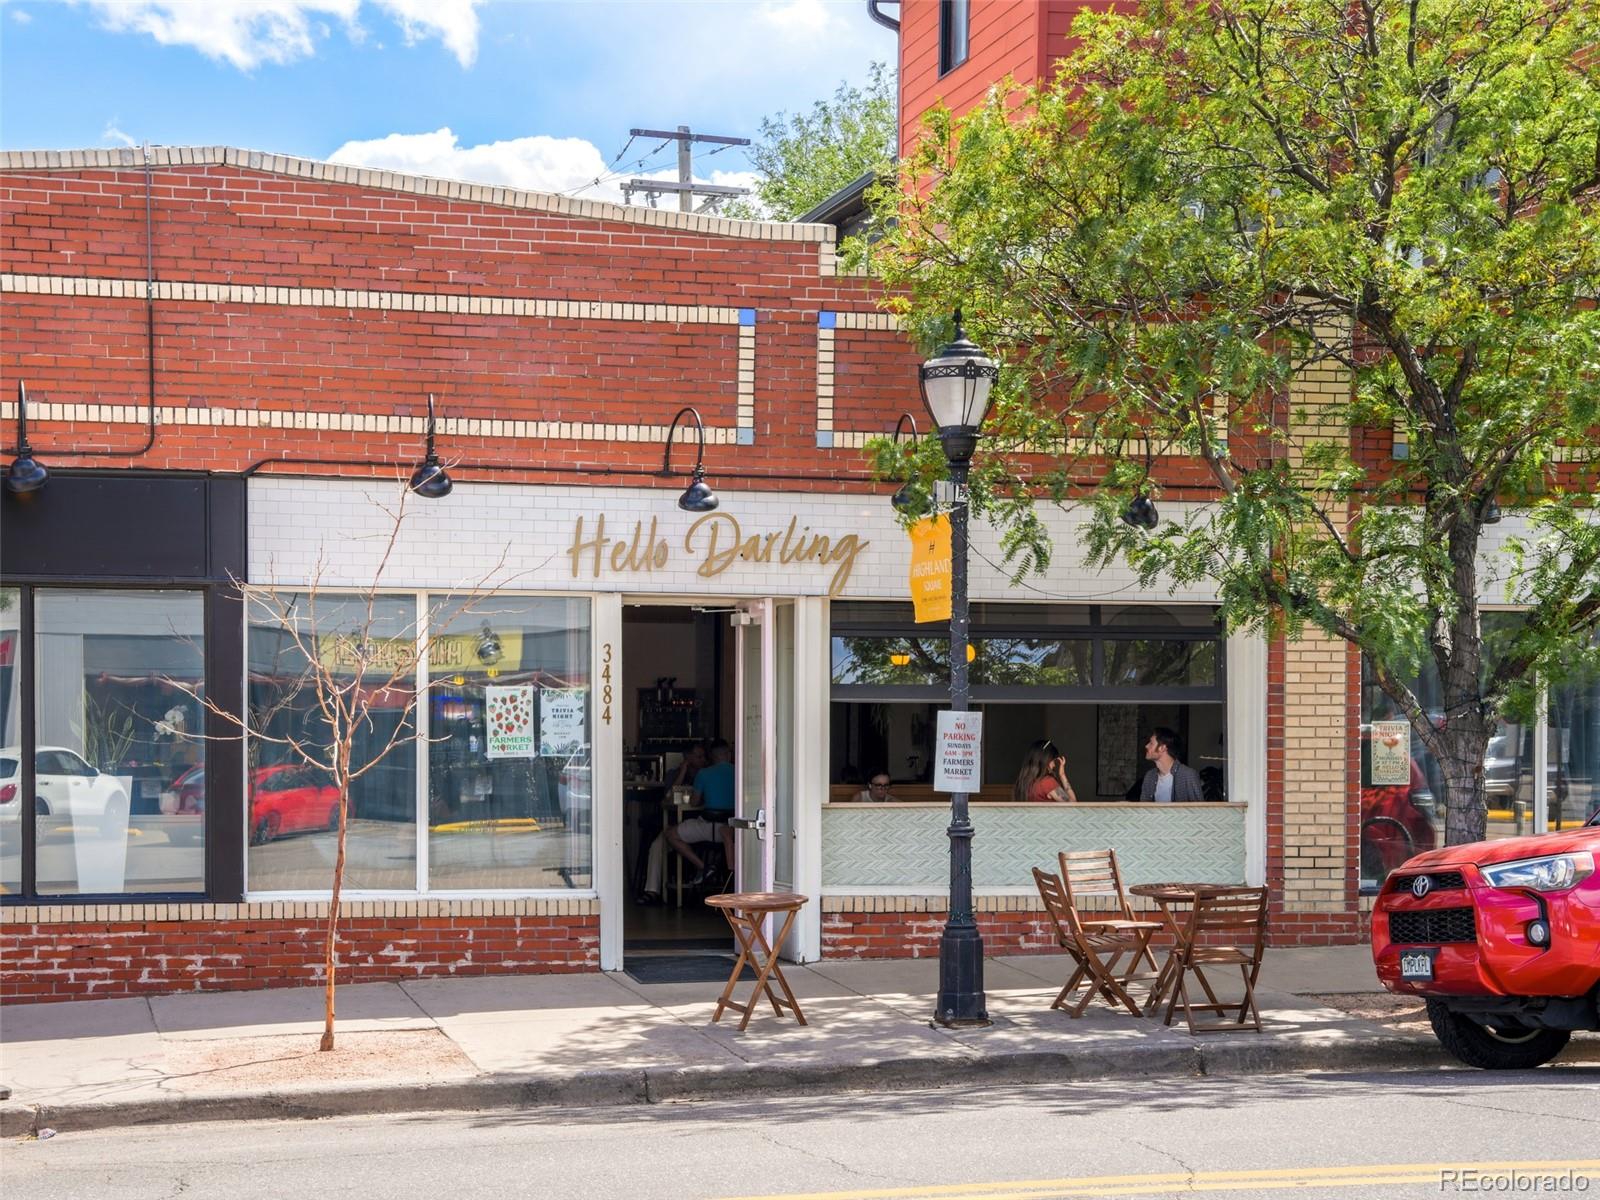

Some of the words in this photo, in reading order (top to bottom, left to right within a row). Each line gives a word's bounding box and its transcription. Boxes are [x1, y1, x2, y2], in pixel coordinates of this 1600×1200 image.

[567, 513, 669, 578] Hello
[684, 511, 870, 599] Darling
[601, 643, 612, 725] 3484
[492, 744, 529, 752] MRKET
[943, 733, 975, 741] PARKING
